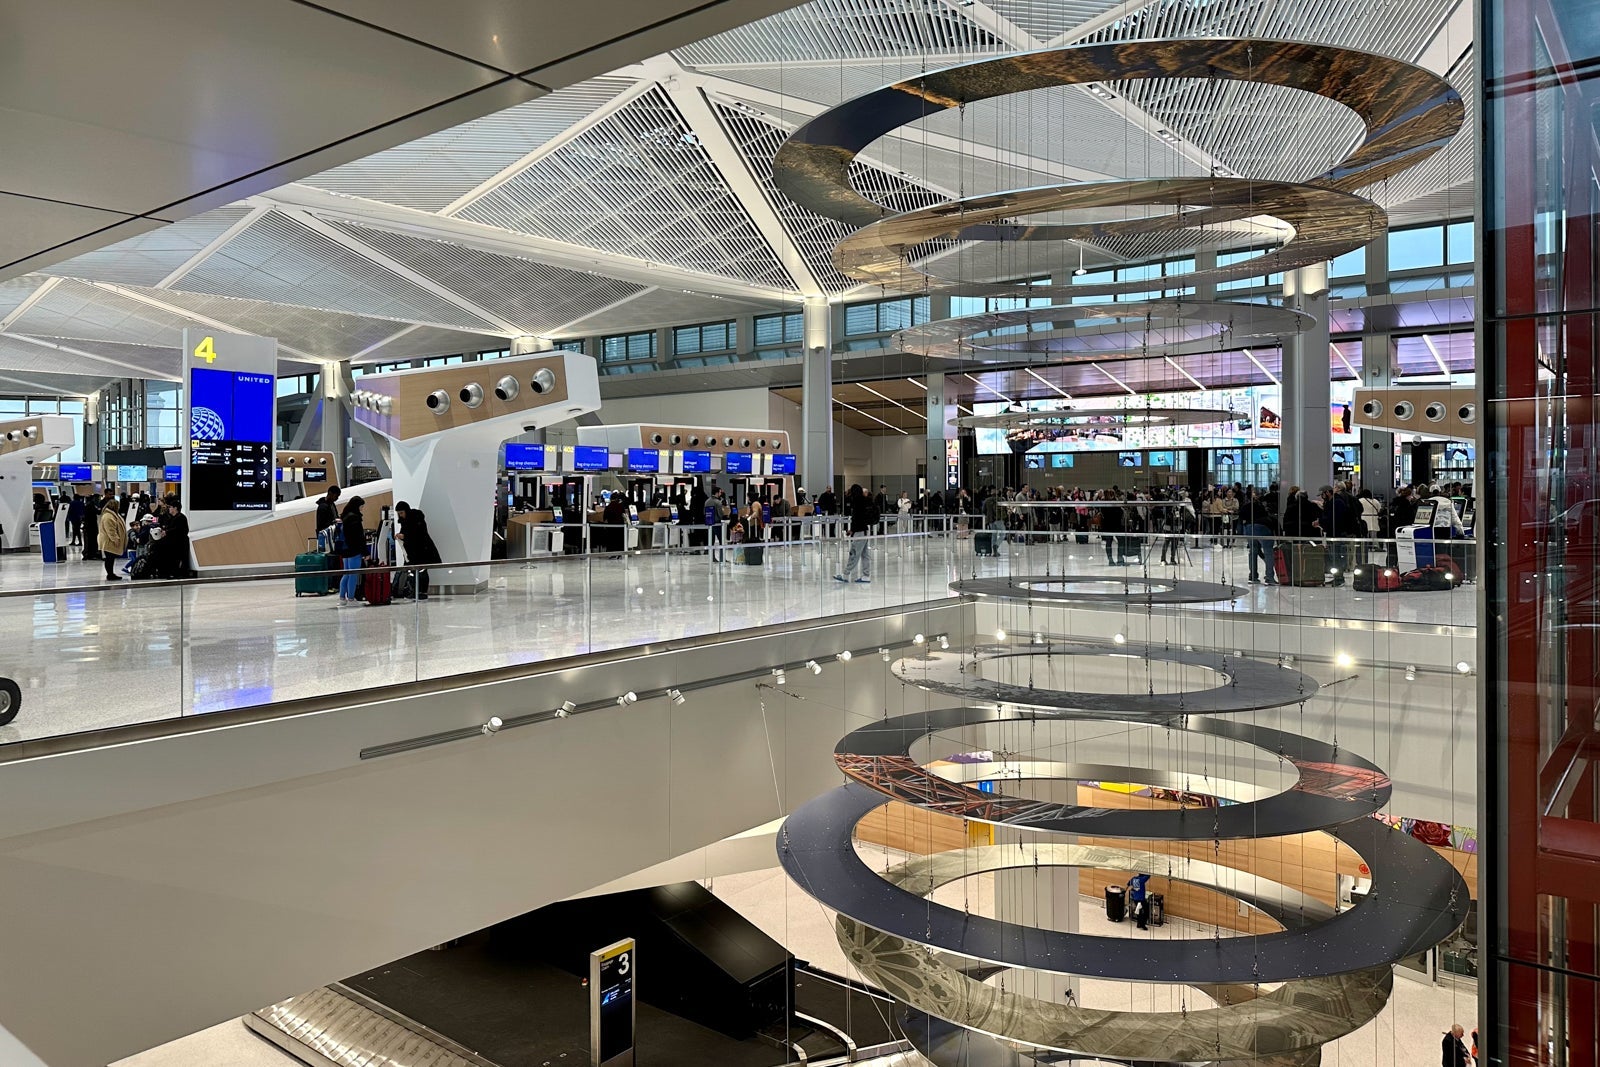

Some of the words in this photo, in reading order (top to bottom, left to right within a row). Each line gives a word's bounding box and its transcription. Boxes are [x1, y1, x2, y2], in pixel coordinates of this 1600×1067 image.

[194, 336, 217, 364] 4
[238, 375, 270, 384] UNITED
[618, 952, 630, 975] 3
